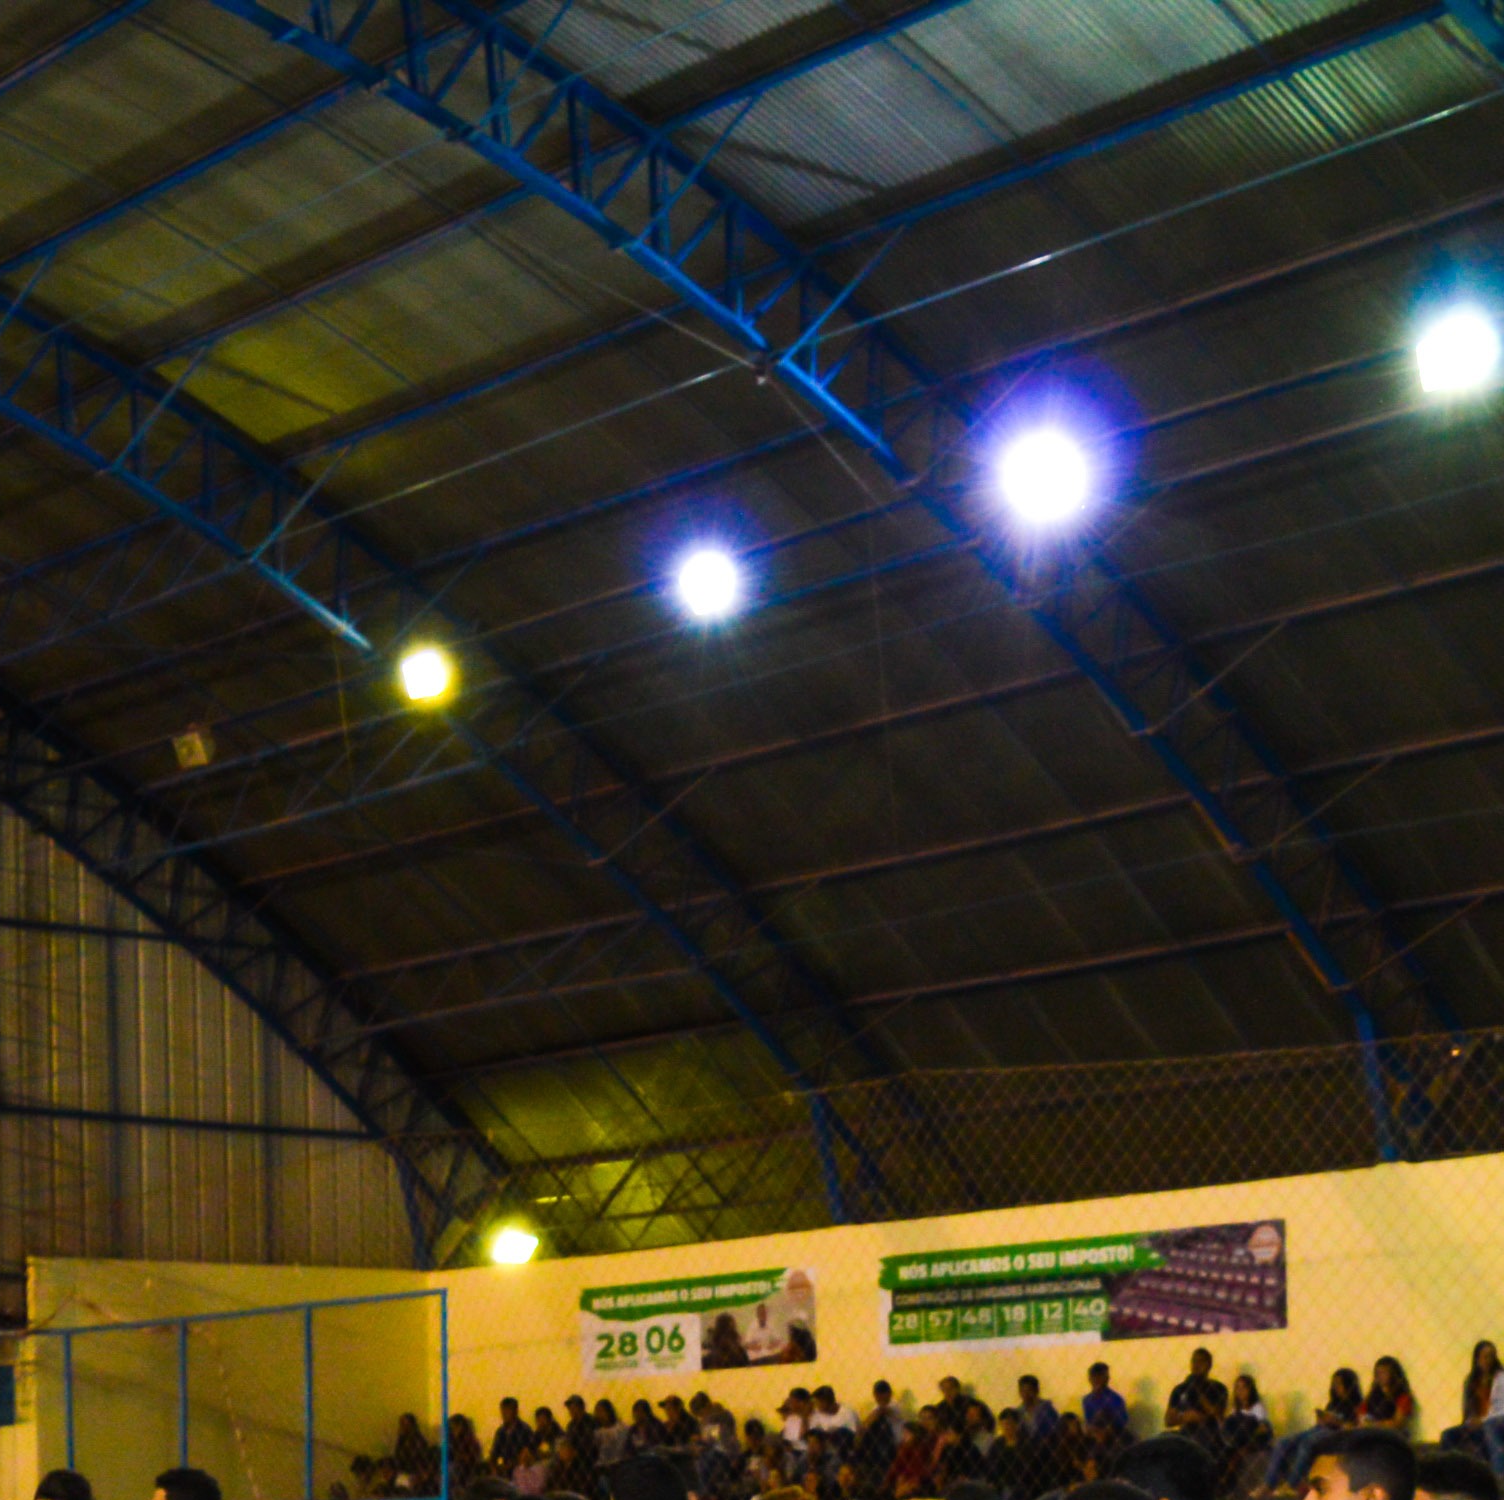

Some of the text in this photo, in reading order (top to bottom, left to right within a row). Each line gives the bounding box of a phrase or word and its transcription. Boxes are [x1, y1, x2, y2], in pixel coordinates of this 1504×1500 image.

[1028, 1251, 1056, 1270] SEU
[893, 1313, 918, 1330] 28
[928, 1310, 954, 1329] 57
[1001, 1304, 1027, 1322] 18
[1041, 1301, 1064, 1320] 12
[1074, 1298, 1106, 1316] 40
[596, 1324, 686, 1358] 28 06
